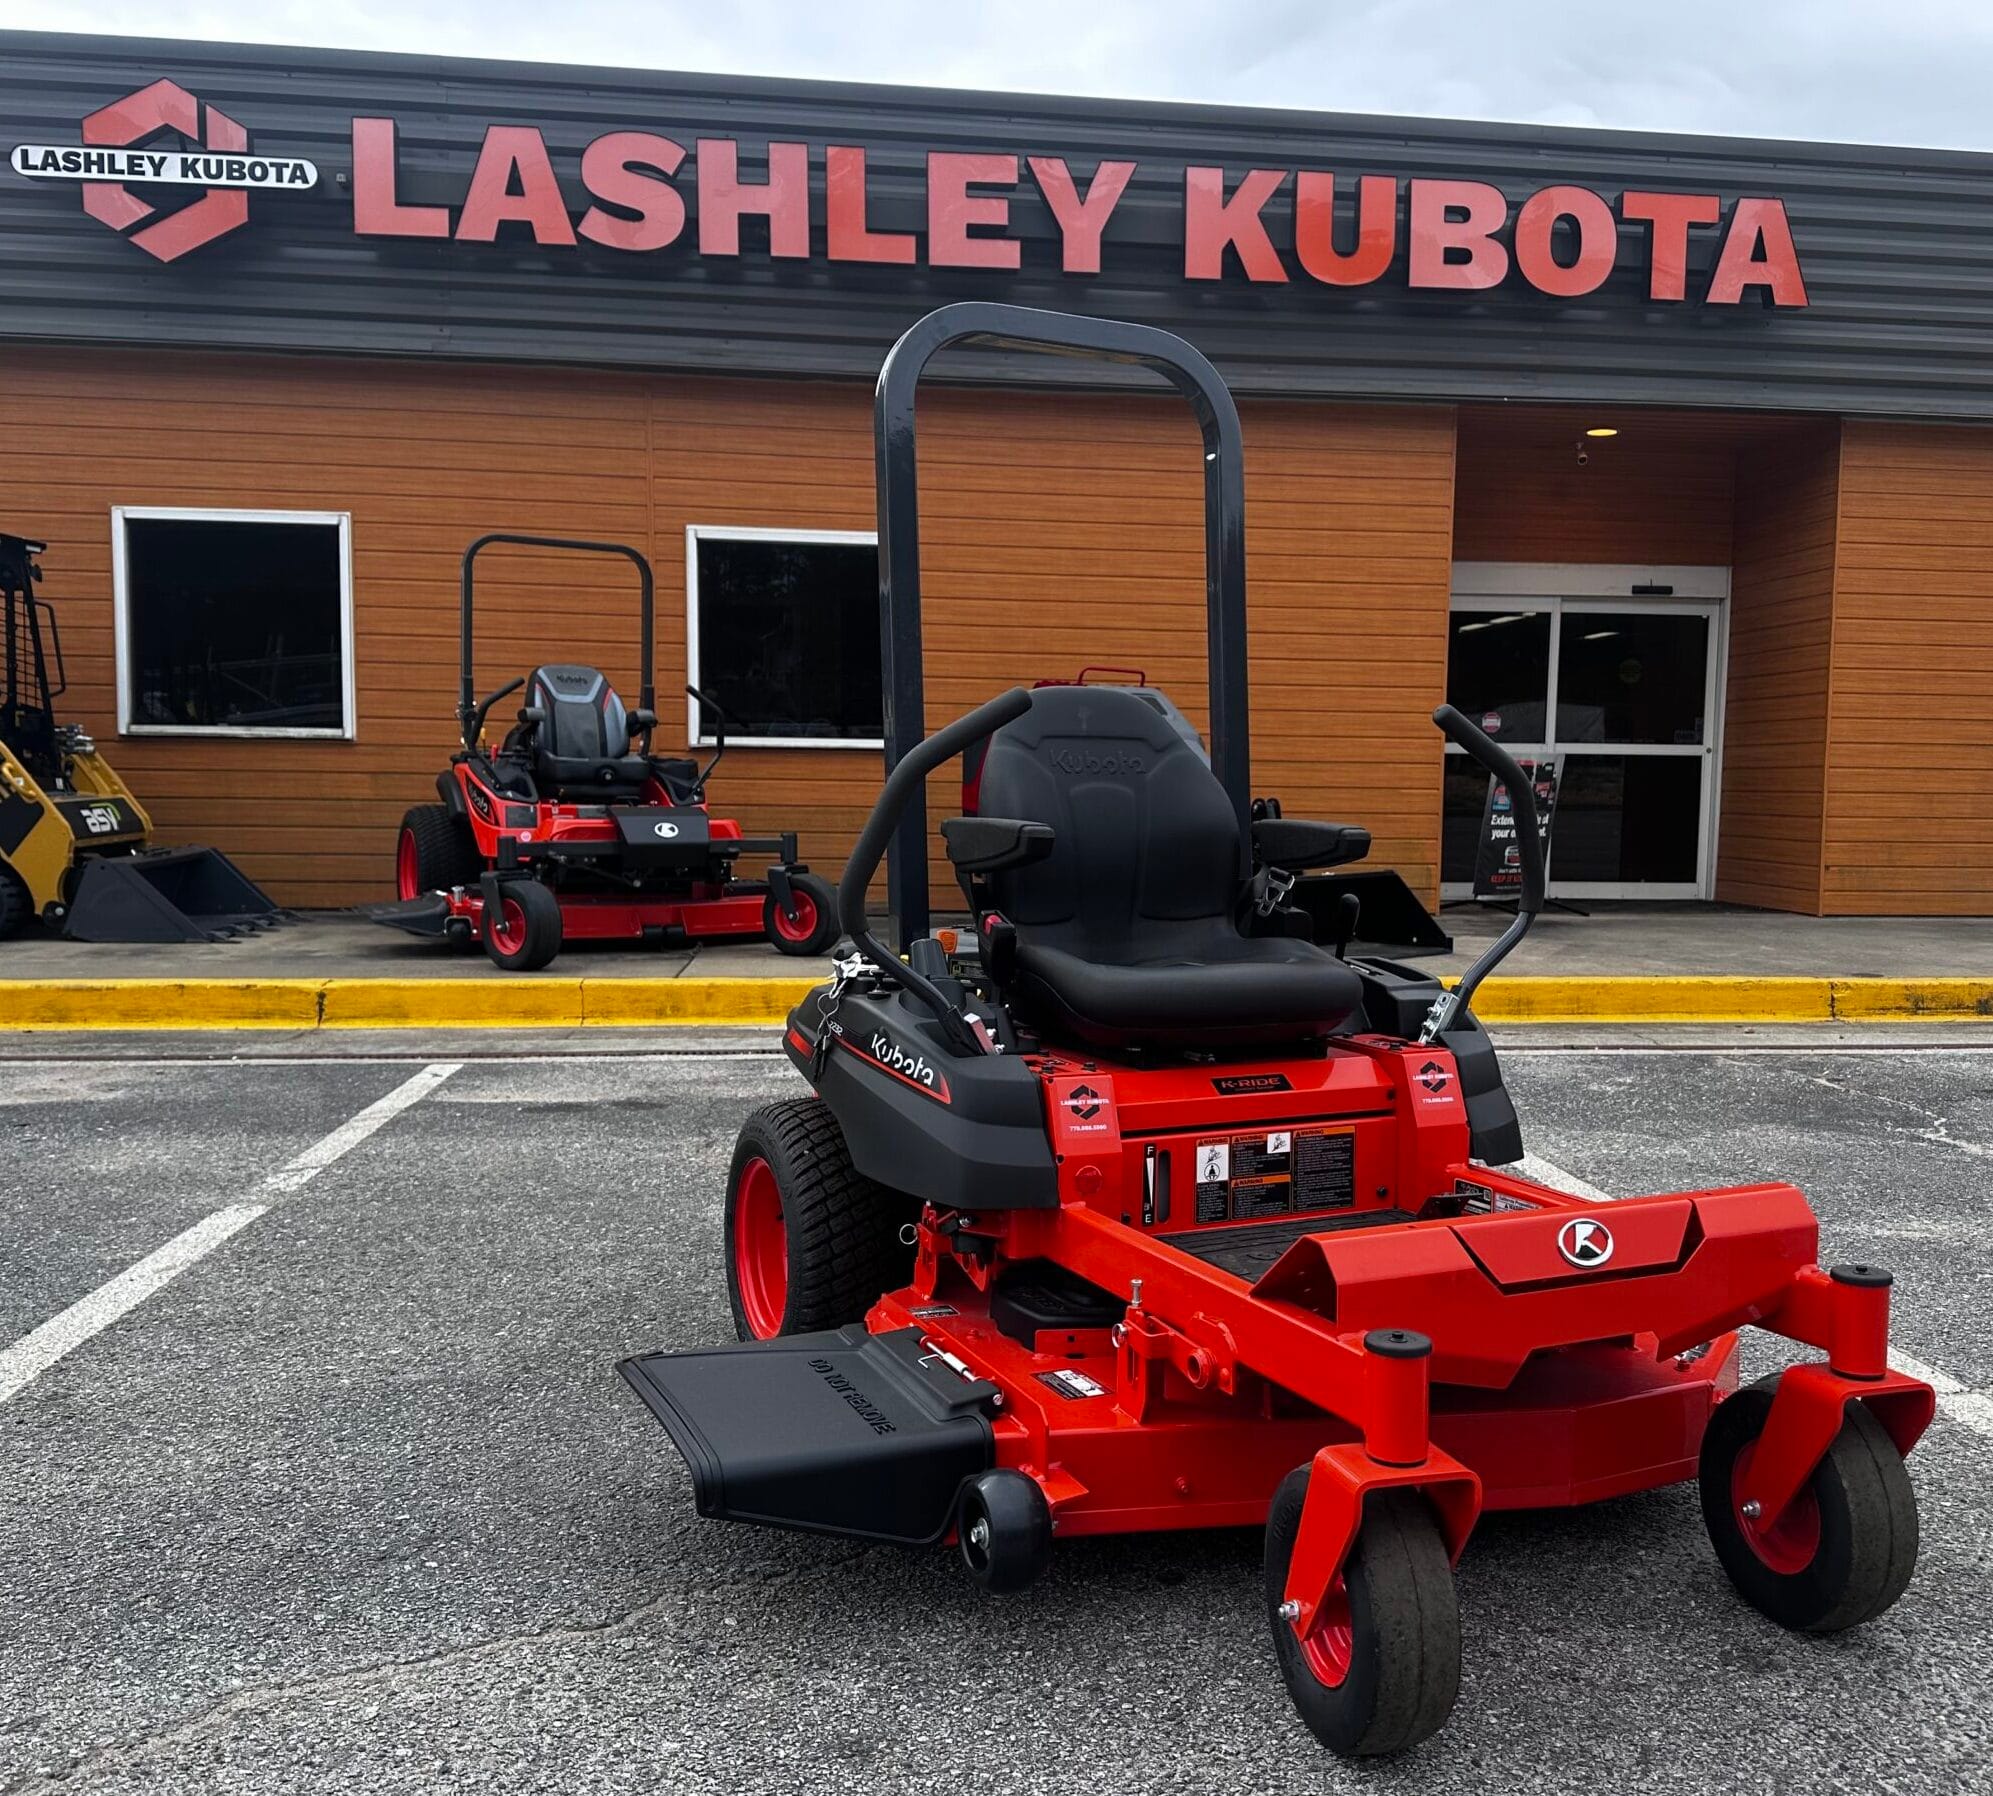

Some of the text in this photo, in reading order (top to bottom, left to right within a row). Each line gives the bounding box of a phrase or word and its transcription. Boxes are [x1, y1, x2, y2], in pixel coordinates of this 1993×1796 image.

[20, 148, 310, 185] LASHLEY KUBOTA
[351, 116, 1810, 307] LASHLEY KUBOTA
[1048, 748, 1147, 776] Kubota
[871, 1033, 934, 1086] Kubota
[1221, 1076, 1281, 1089] K-RIDE
